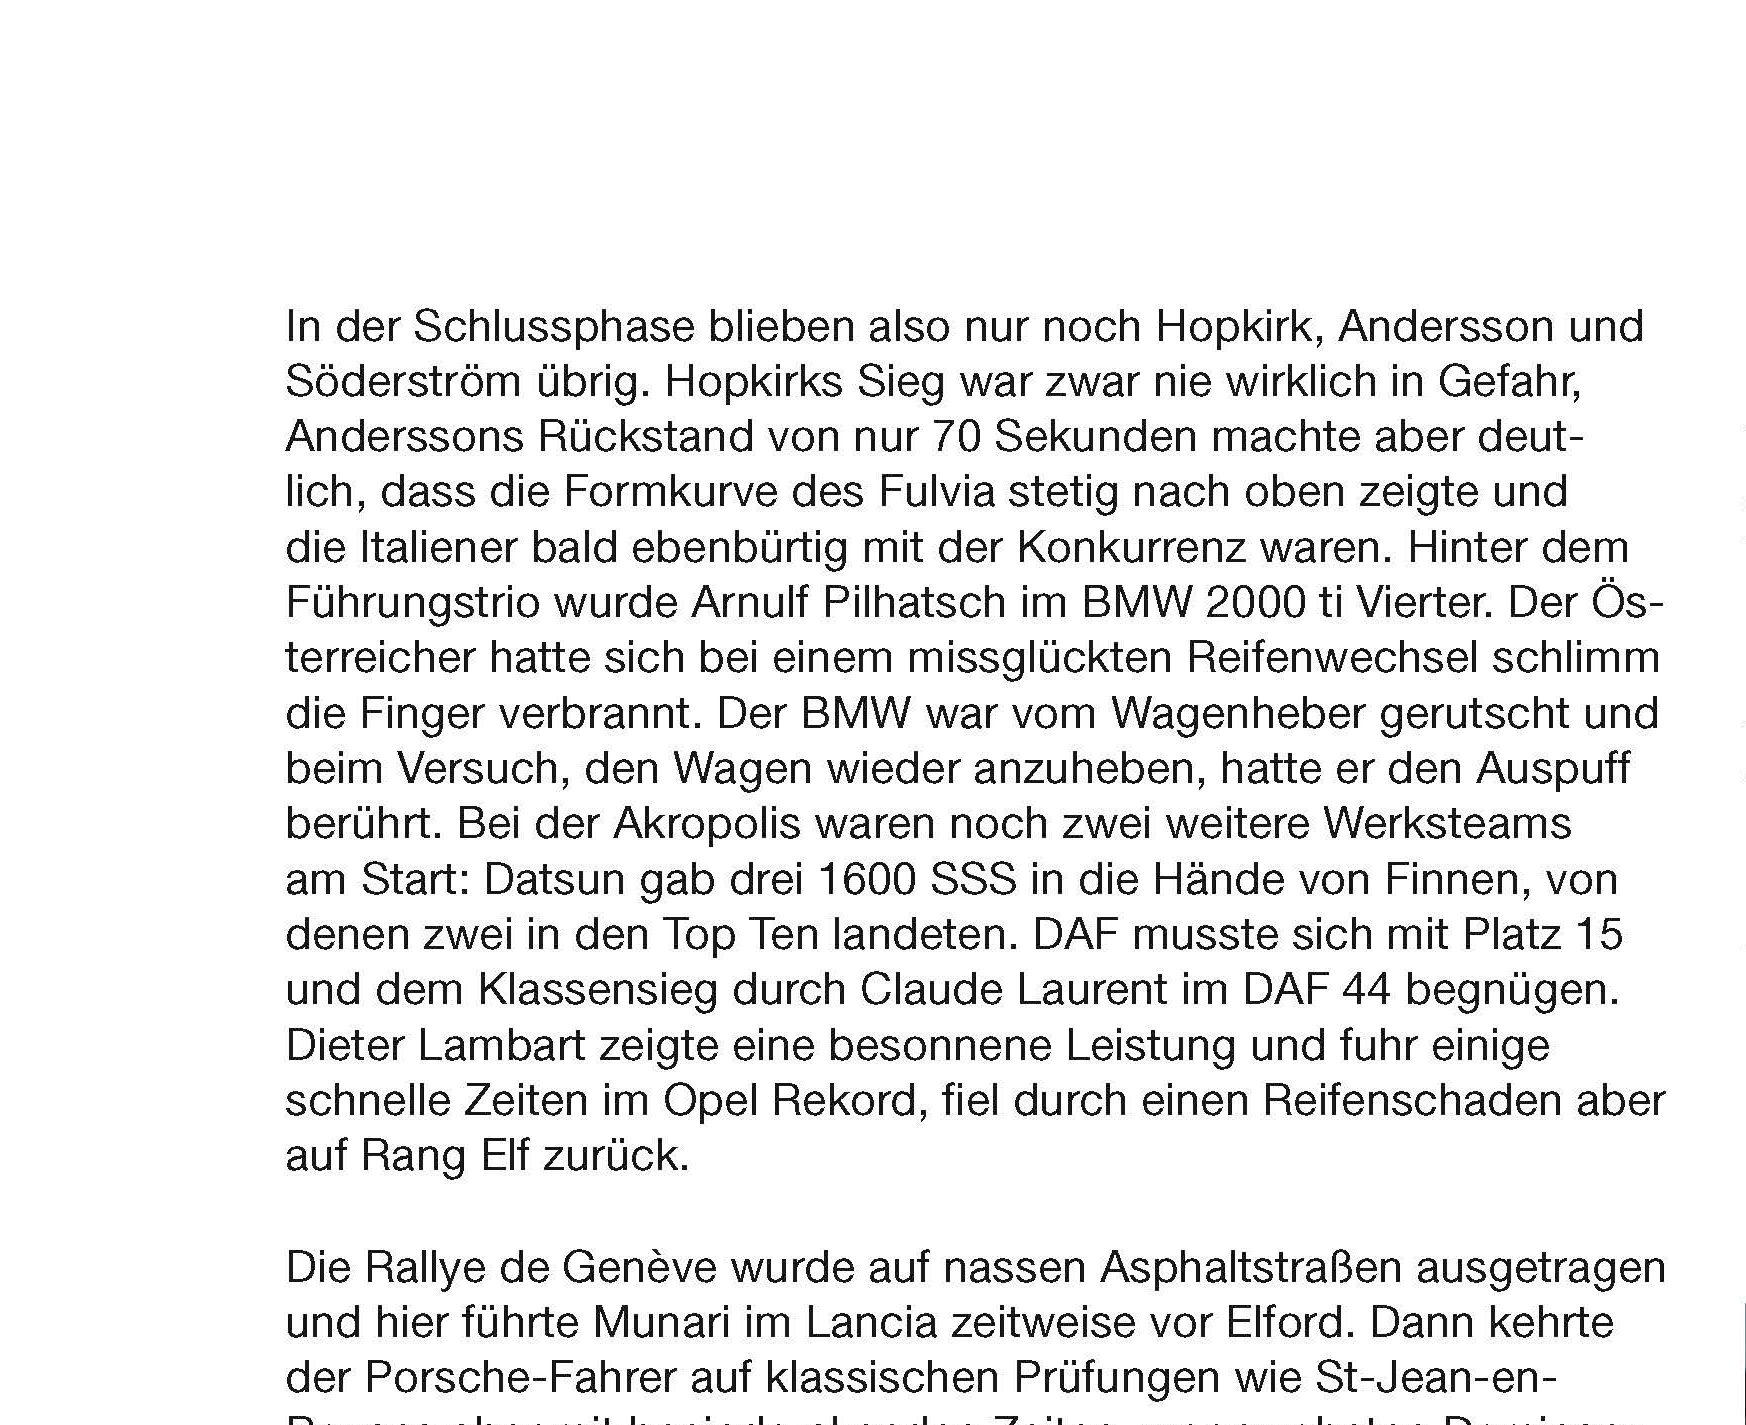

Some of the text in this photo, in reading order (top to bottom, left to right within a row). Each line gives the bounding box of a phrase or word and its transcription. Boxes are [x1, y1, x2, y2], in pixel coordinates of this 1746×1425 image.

[288, 307, 1643, 351] In der Schlussphase blieben also nur noch Hopkirk, Andersson und
[288, 583, 1664, 628] Führungstrio wurde Arnulf Pilhatsch im BMW 2000 ti Vierter. Der Ös-
[286, 860, 1617, 905] am Start: Datsun gab drei 1600 SSS in die Hände von Finnen, von
[288, 1248, 1665, 1293] Die Rallye de Genève wurde auf nassen Asphaltstraßen ausgetragen
